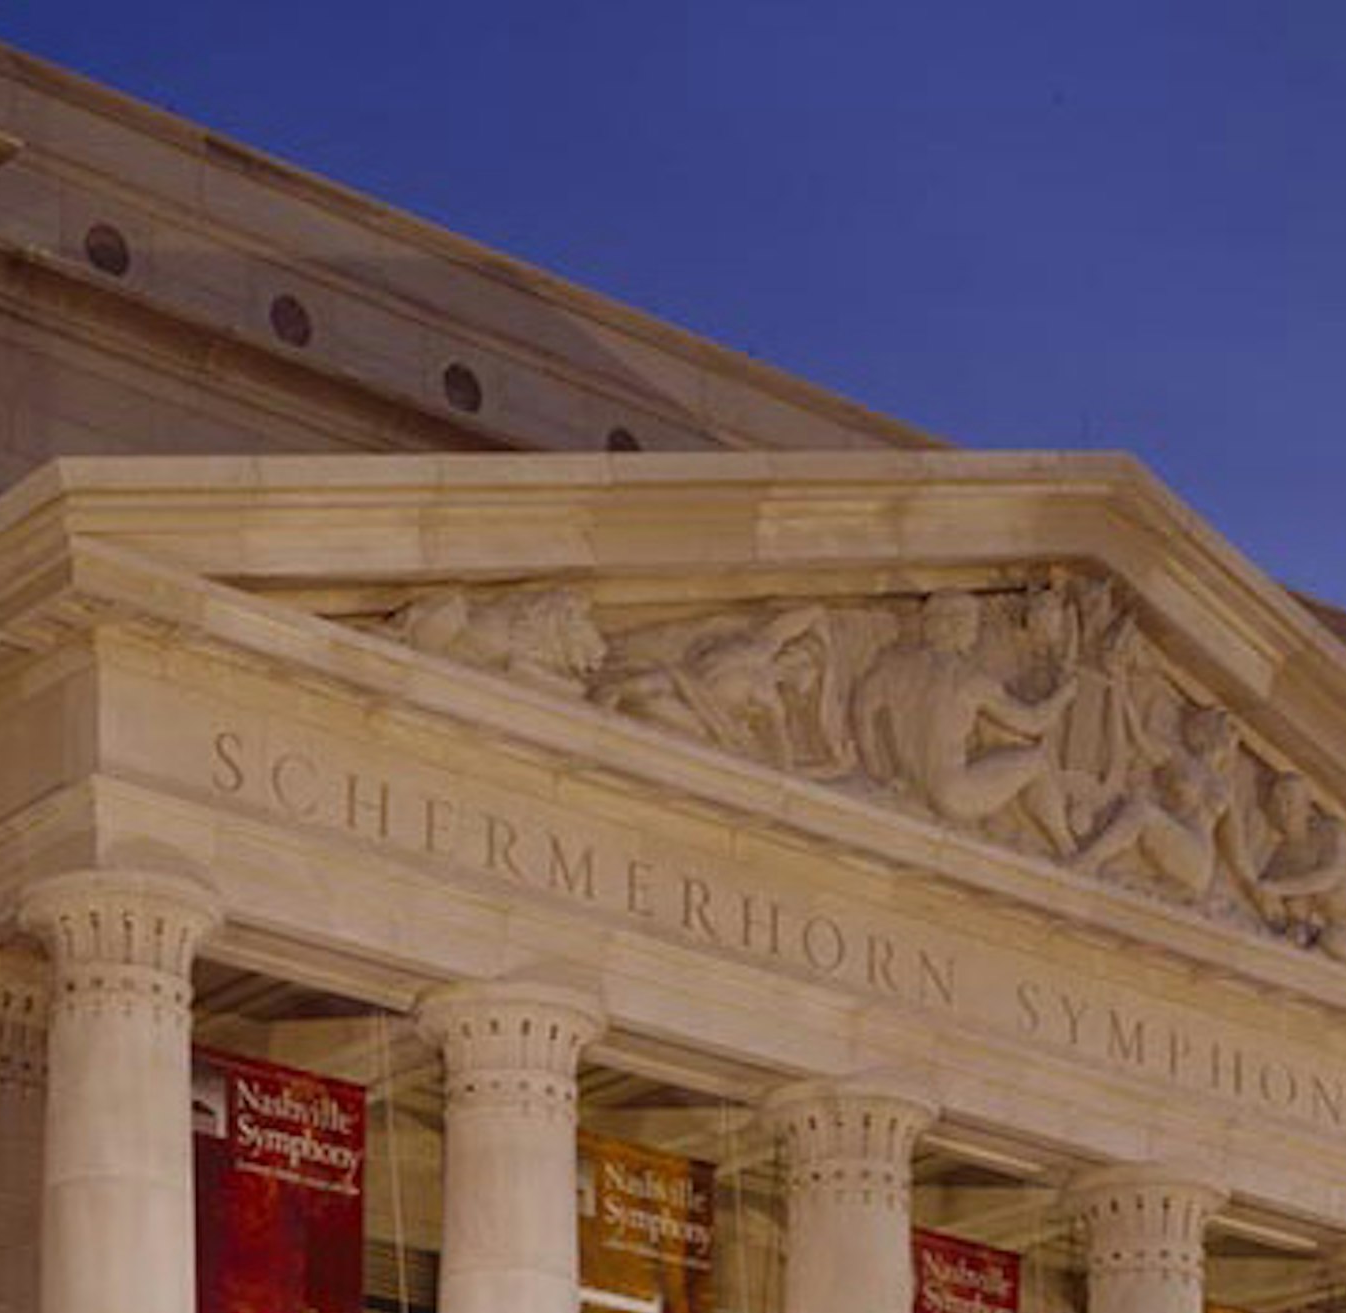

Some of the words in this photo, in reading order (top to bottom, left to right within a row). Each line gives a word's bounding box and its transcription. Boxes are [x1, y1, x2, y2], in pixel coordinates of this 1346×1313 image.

[211, 730, 956, 1004] SCHERMERHORN
[236, 1078, 356, 1135] Nashville
[237, 1112, 362, 1182] Symphony
